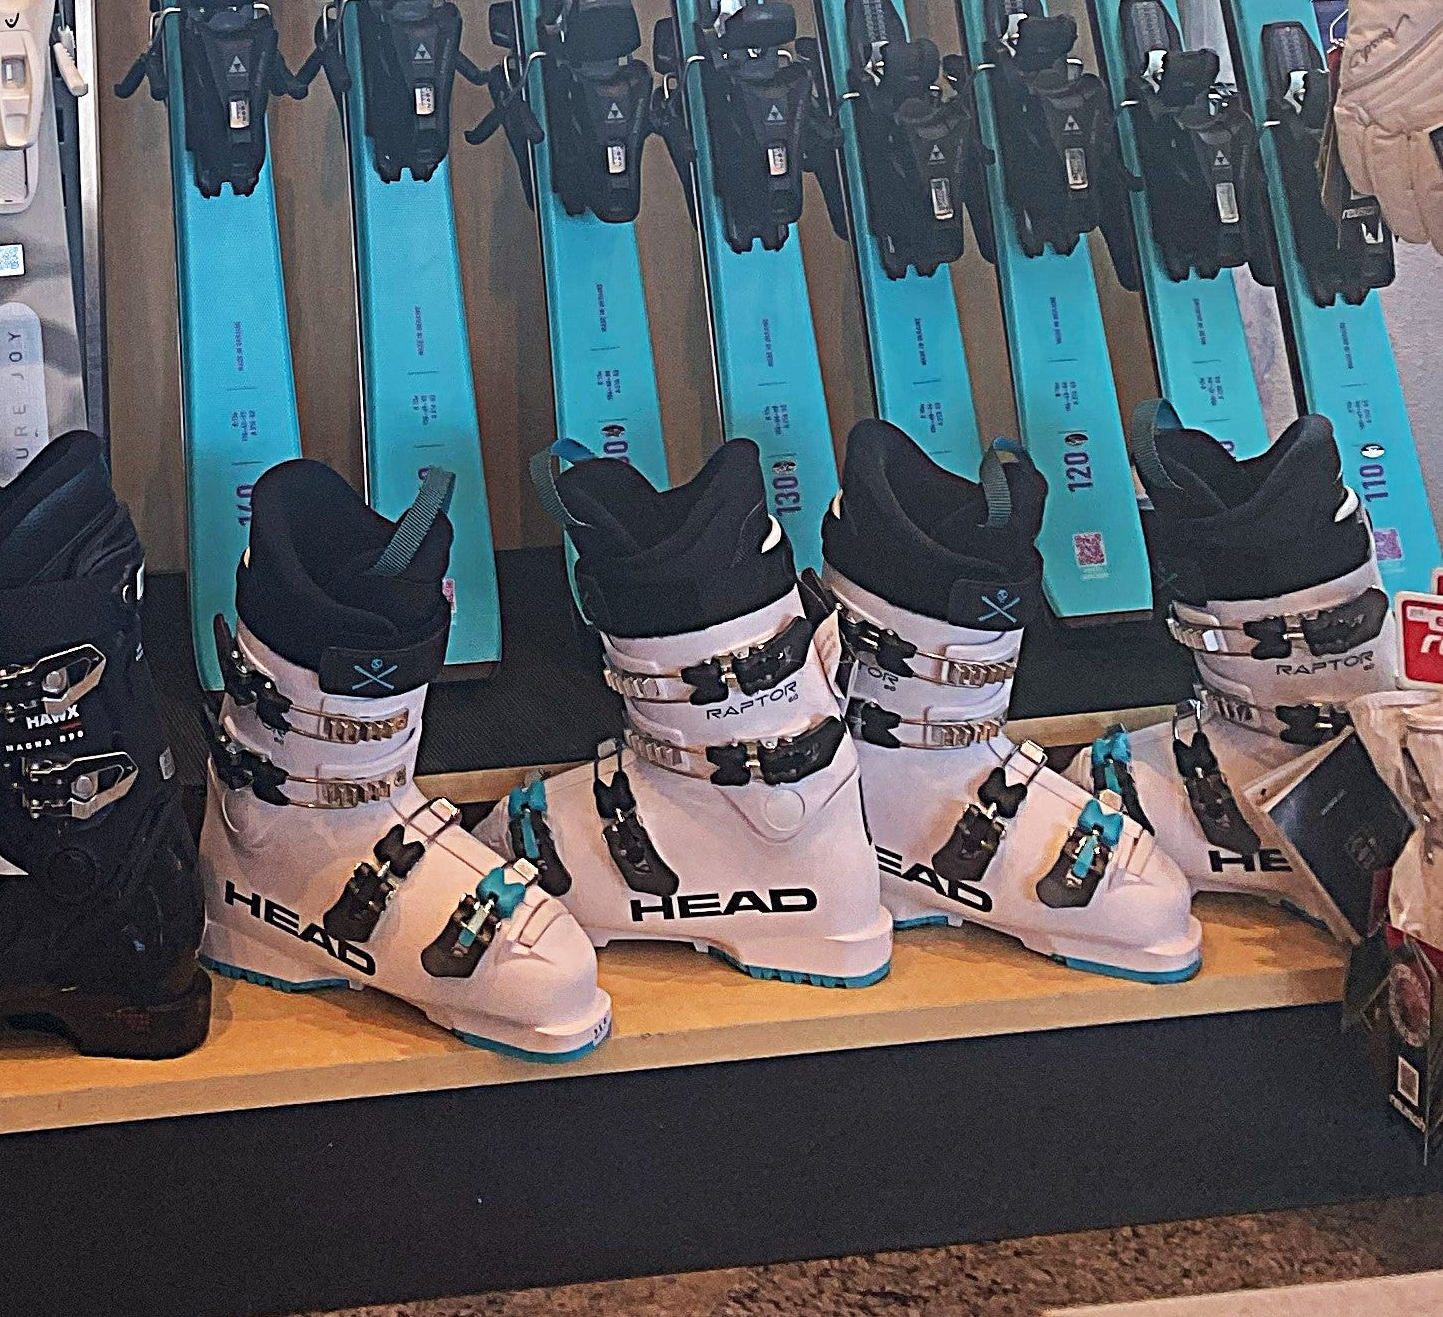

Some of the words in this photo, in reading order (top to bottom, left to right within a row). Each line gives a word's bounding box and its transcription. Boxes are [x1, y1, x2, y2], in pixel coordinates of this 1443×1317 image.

[7, 329, 25, 382] JOY
[11, 403, 30, 460] URE
[1066, 450, 1095, 493] 120
[1360, 461, 1390, 504] 110
[771, 474, 802, 517] 130
[1275, 650, 1374, 676] RAPTOR
[25, 704, 80, 730] HAWX
[705, 679, 798, 720] RAPTOR
[876, 845, 994, 913] EAD
[1208, 848, 1293, 873] HE
[628, 887, 819, 923] HEAD
[224, 880, 377, 976] HEAD
